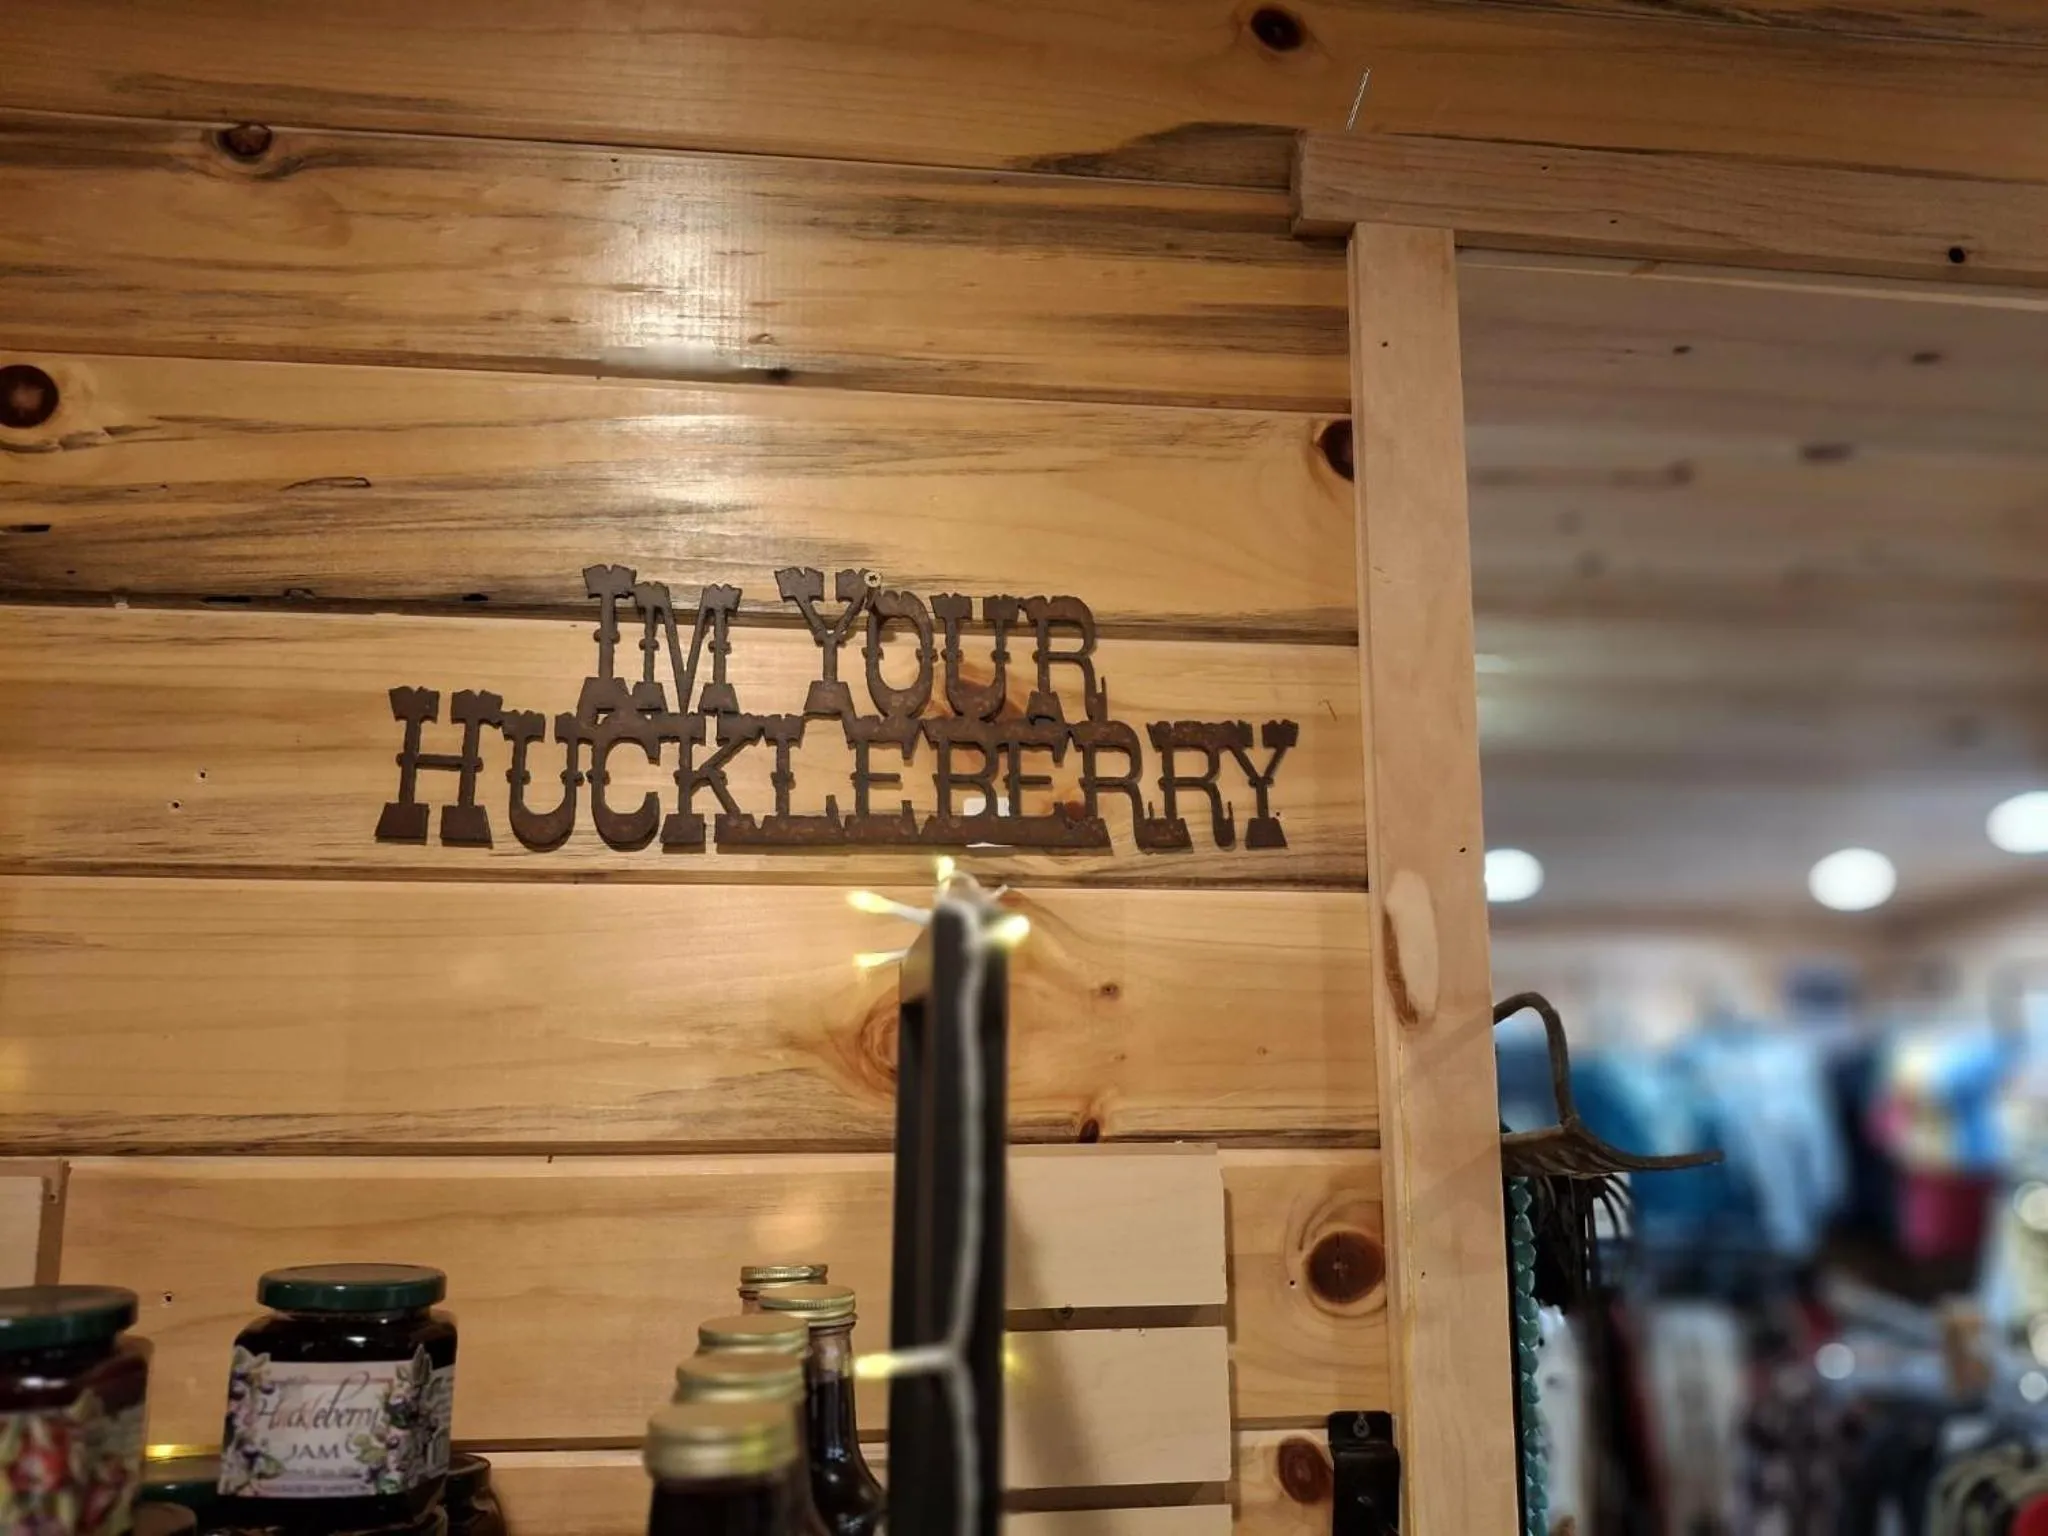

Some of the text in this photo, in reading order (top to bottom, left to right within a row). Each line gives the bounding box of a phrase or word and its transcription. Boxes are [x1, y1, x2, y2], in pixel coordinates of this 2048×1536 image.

[577, 563, 1106, 722] IM YOUR
[375, 686, 1299, 854] HUCKLEBERRY
[257, 1370, 381, 1432] Huckleberry
[284, 1443, 340, 1461] JAM
